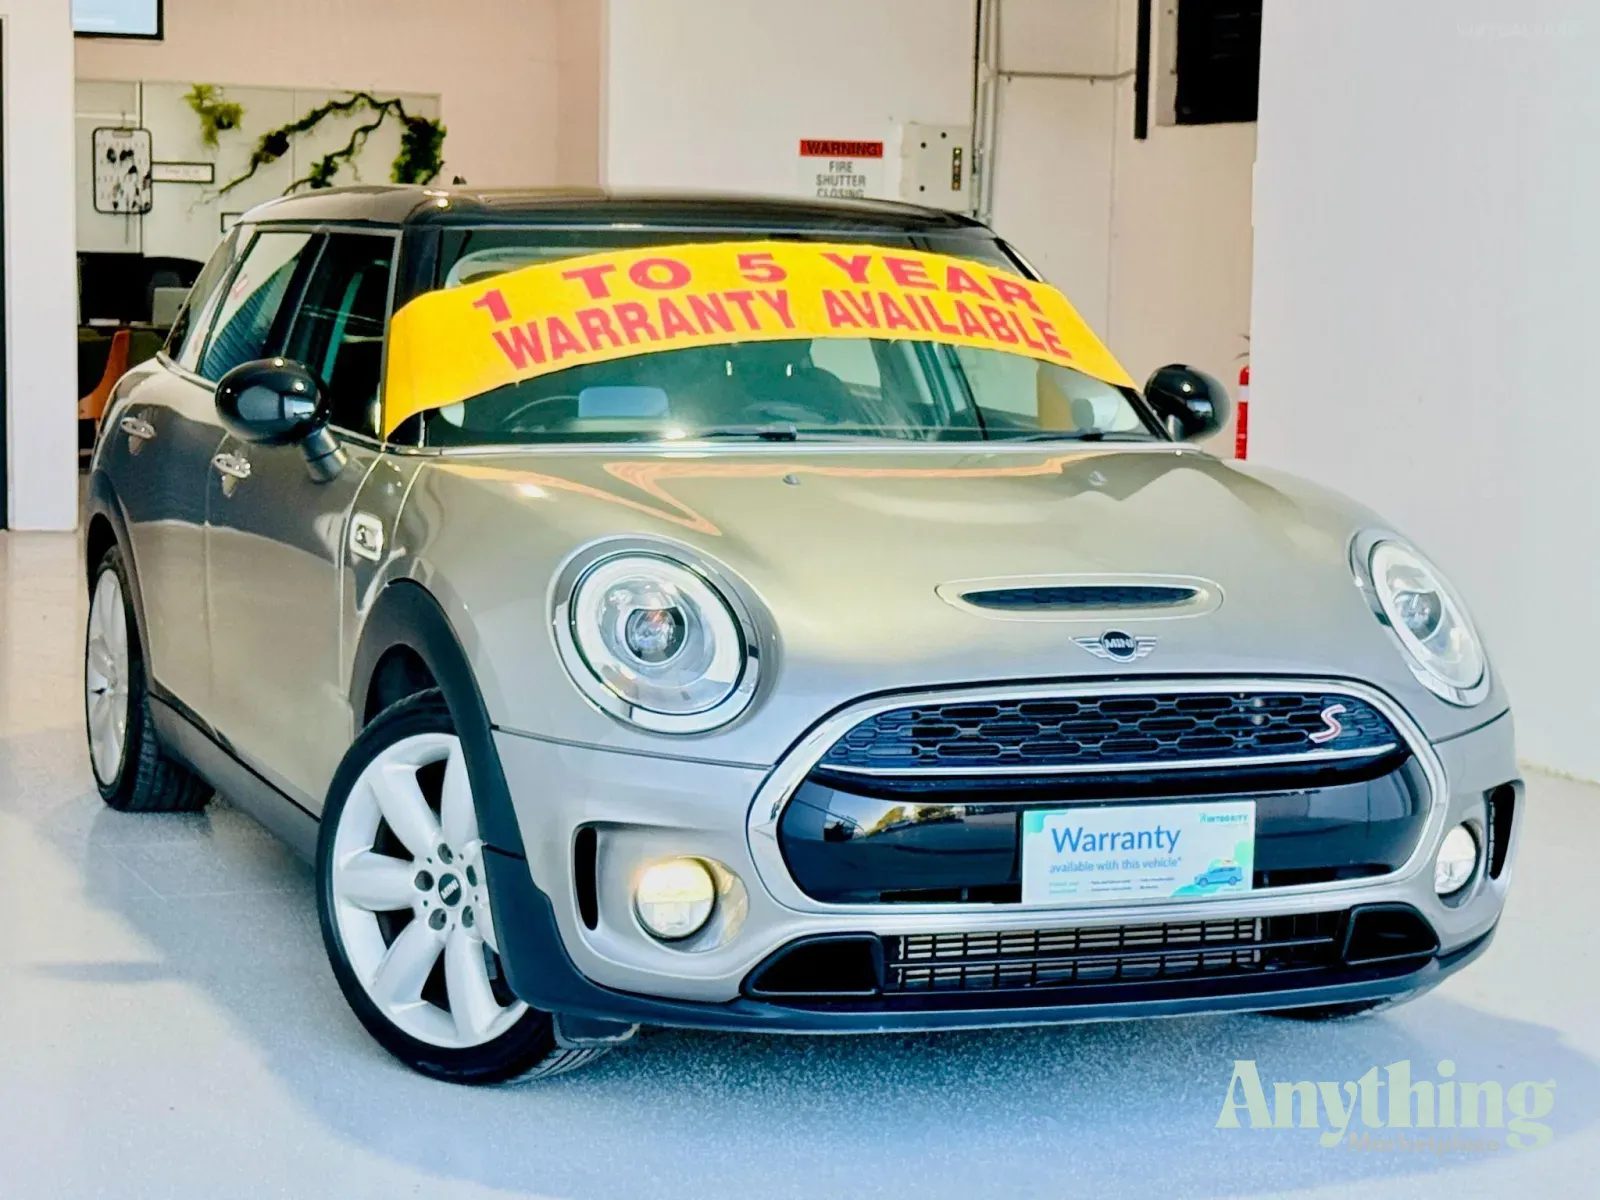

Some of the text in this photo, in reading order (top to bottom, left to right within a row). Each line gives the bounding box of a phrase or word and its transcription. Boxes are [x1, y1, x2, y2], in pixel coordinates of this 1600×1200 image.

[806, 140, 877, 155] WARNING
[829, 161, 852, 173] FIRE
[815, 174, 866, 187] SHUTTER
[816, 188, 864, 199] CLOSING
[472, 252, 1044, 323] 1 TO 5 YEAR
[491, 289, 1073, 371] WARRANTY AVAILABLE
[1105, 638, 1134, 649] MINI
[1308, 703, 1347, 744] S
[1051, 824, 1181, 854] Warranty
[1049, 860, 1094, 874] available
[1096, 859, 1120, 871] with
[1122, 857, 1140, 870] this
